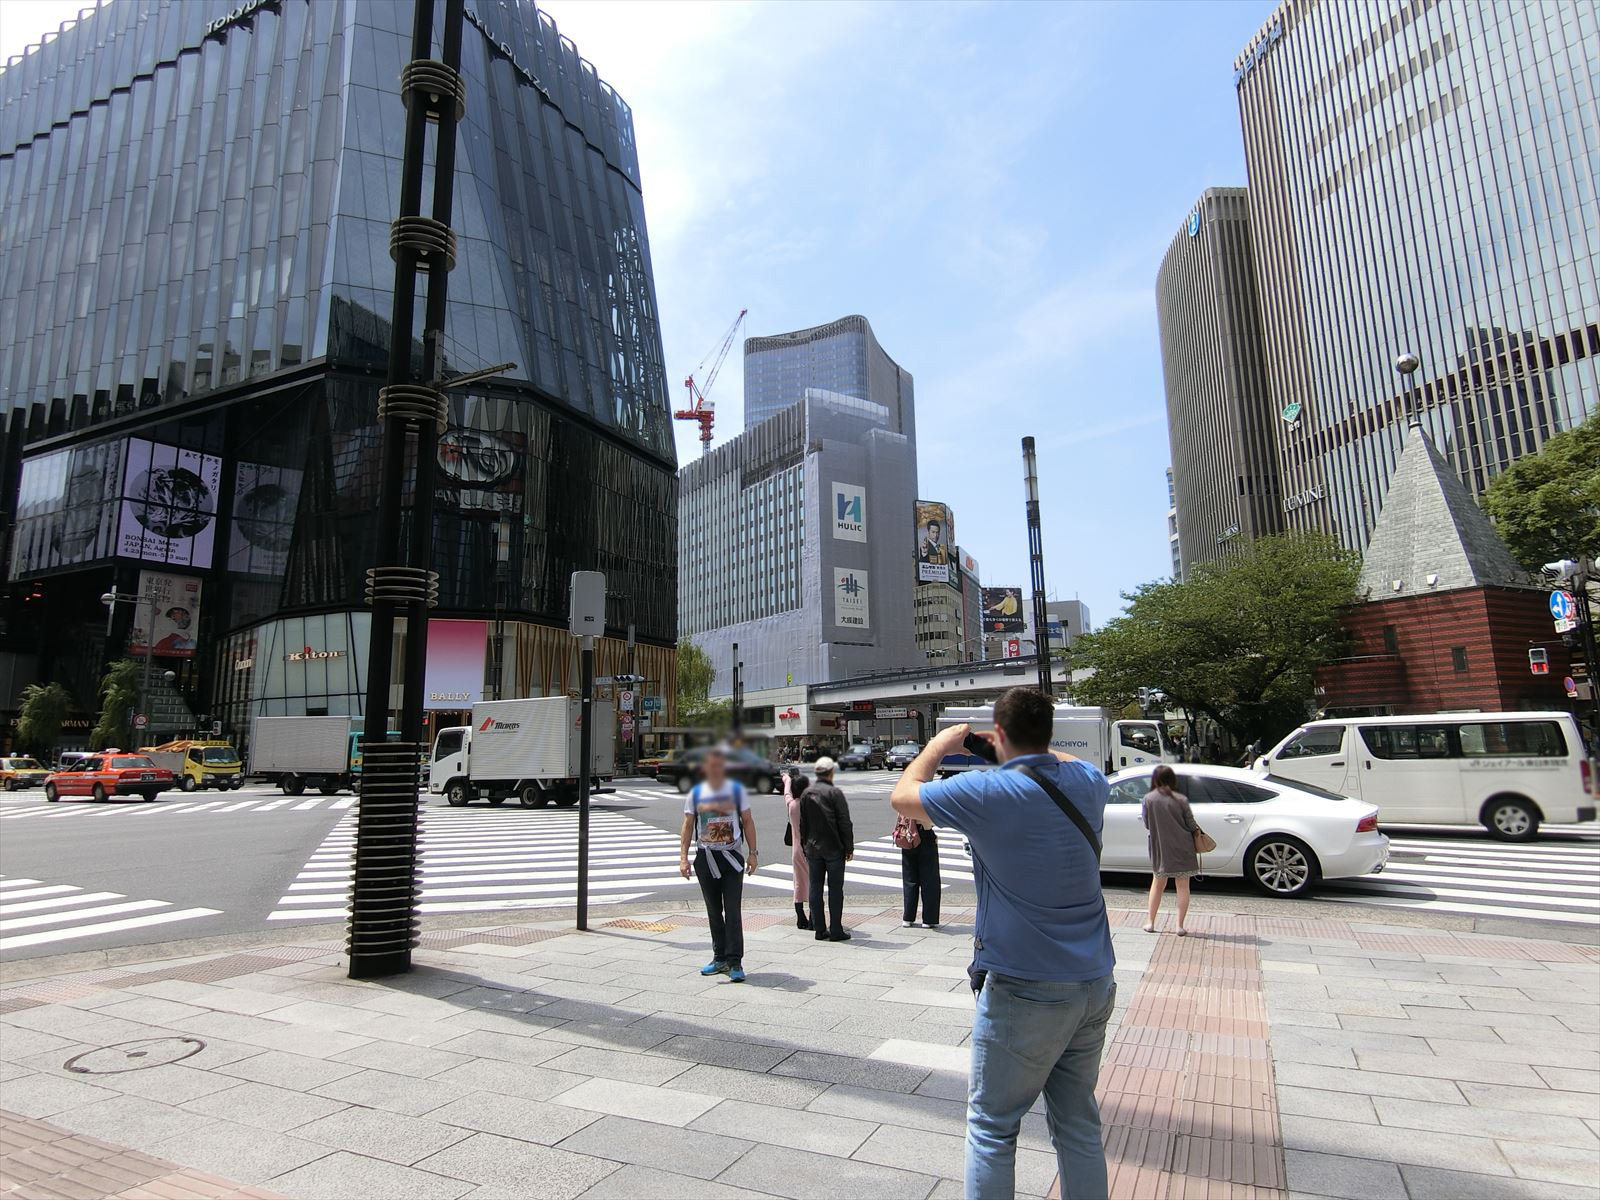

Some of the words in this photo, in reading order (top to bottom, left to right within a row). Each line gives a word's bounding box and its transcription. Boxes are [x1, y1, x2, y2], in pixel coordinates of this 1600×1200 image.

[1283, 483, 1326, 513] LUMINE
[838, 522, 862, 532] HULIC
[125, 534, 156, 544] BONSAI
[842, 597, 863, 605] TAISEI
[288, 647, 338, 661] Kiton
[431, 692, 470, 700] BALLY
